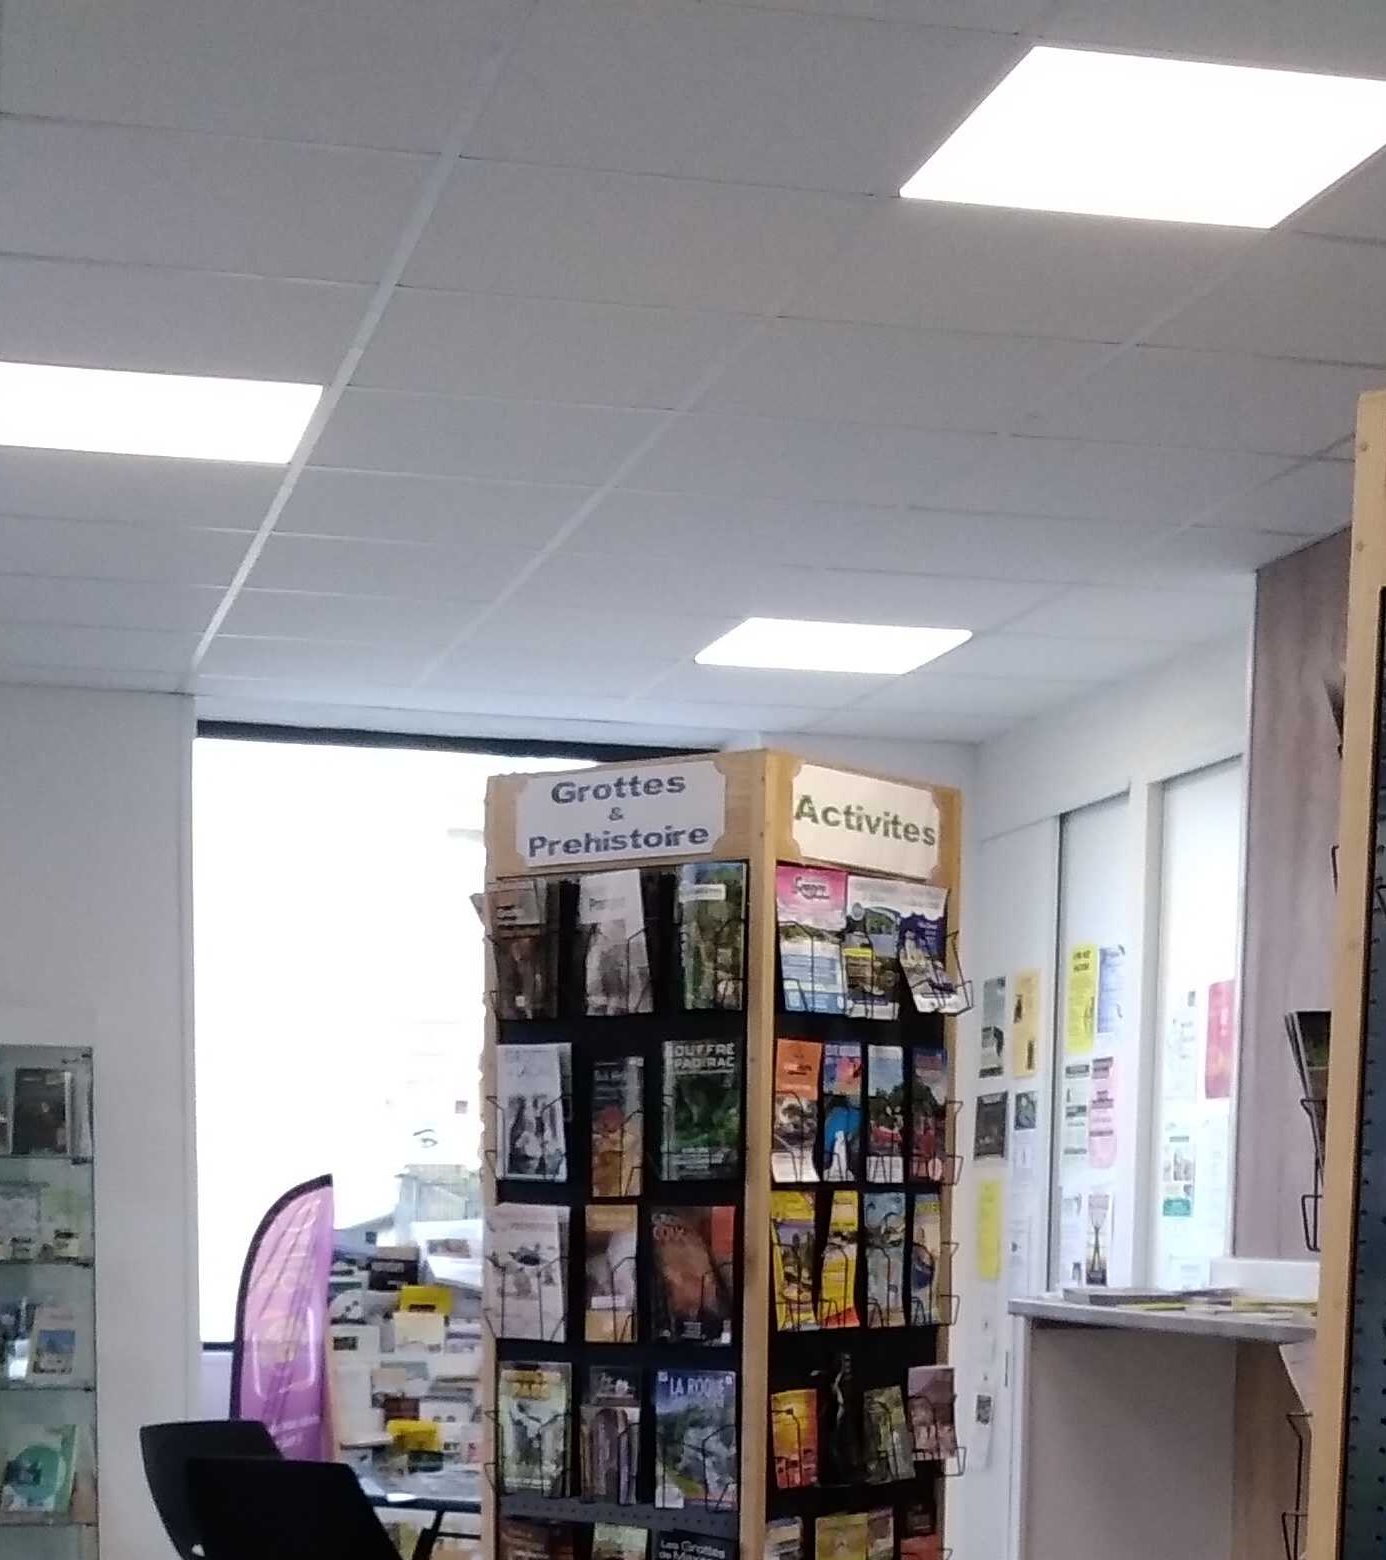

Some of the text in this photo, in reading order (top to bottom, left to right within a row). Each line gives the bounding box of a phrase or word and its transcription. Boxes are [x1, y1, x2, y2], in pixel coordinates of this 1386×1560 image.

[550, 773, 687, 804] Grottes
[608, 806, 625, 823] &
[794, 793, 936, 847] Activites
[528, 825, 710, 858] Prehistoire
